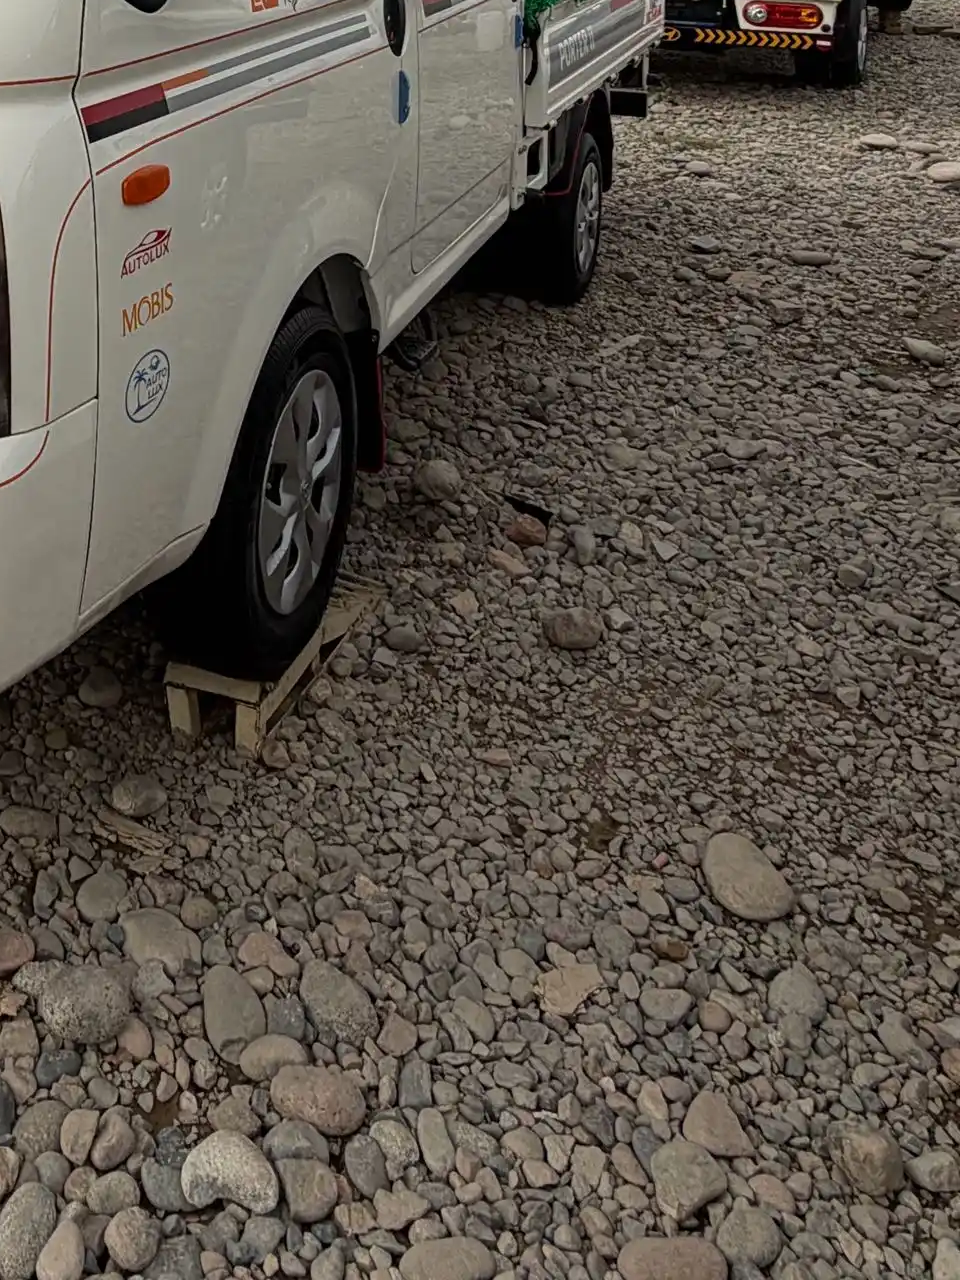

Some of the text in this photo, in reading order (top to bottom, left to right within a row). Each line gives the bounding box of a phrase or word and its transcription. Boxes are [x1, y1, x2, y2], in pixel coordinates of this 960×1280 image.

[558, 29, 589, 71] PORTER
[121, 241, 171, 279] AUTOLUX
[121, 282, 174, 337] MOBIS
[145, 367, 168, 389] AUTO
